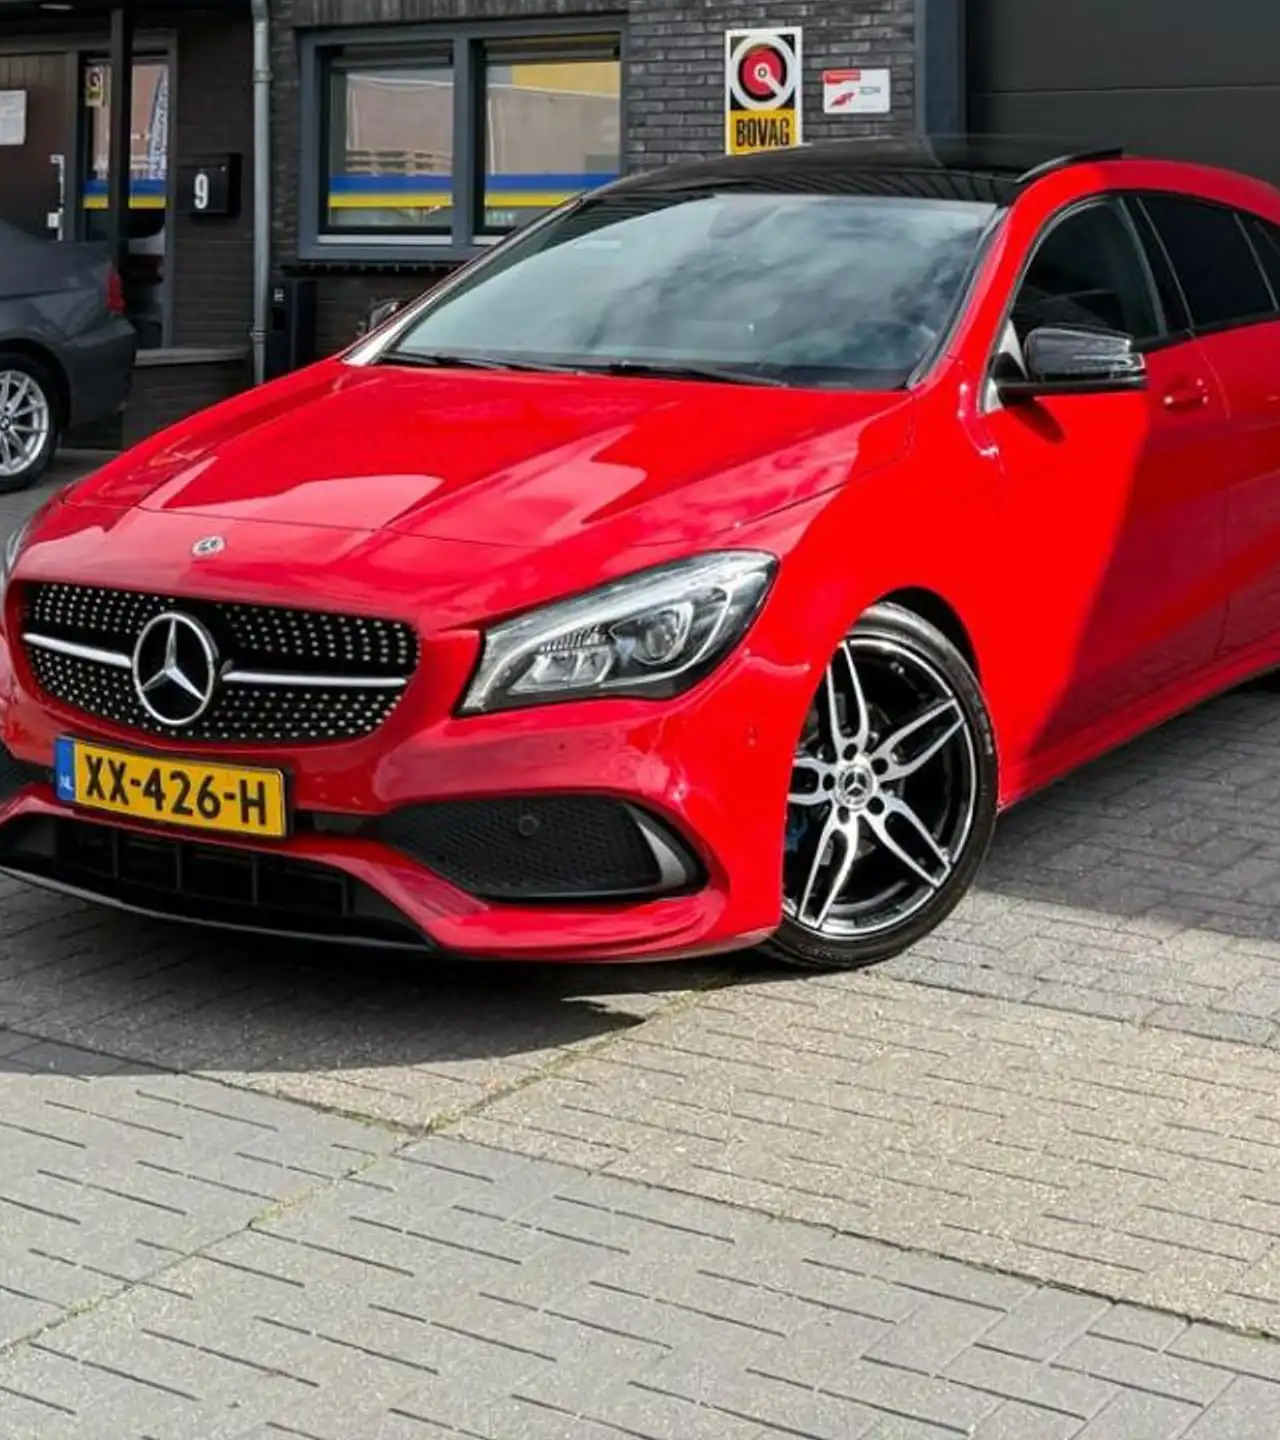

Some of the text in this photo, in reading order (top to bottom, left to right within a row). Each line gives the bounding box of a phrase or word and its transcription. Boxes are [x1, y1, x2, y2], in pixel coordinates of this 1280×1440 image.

[735, 117, 791, 148] BOVAG
[194, 173, 209, 210] 9
[85, 754, 267, 826] XX-426-H
